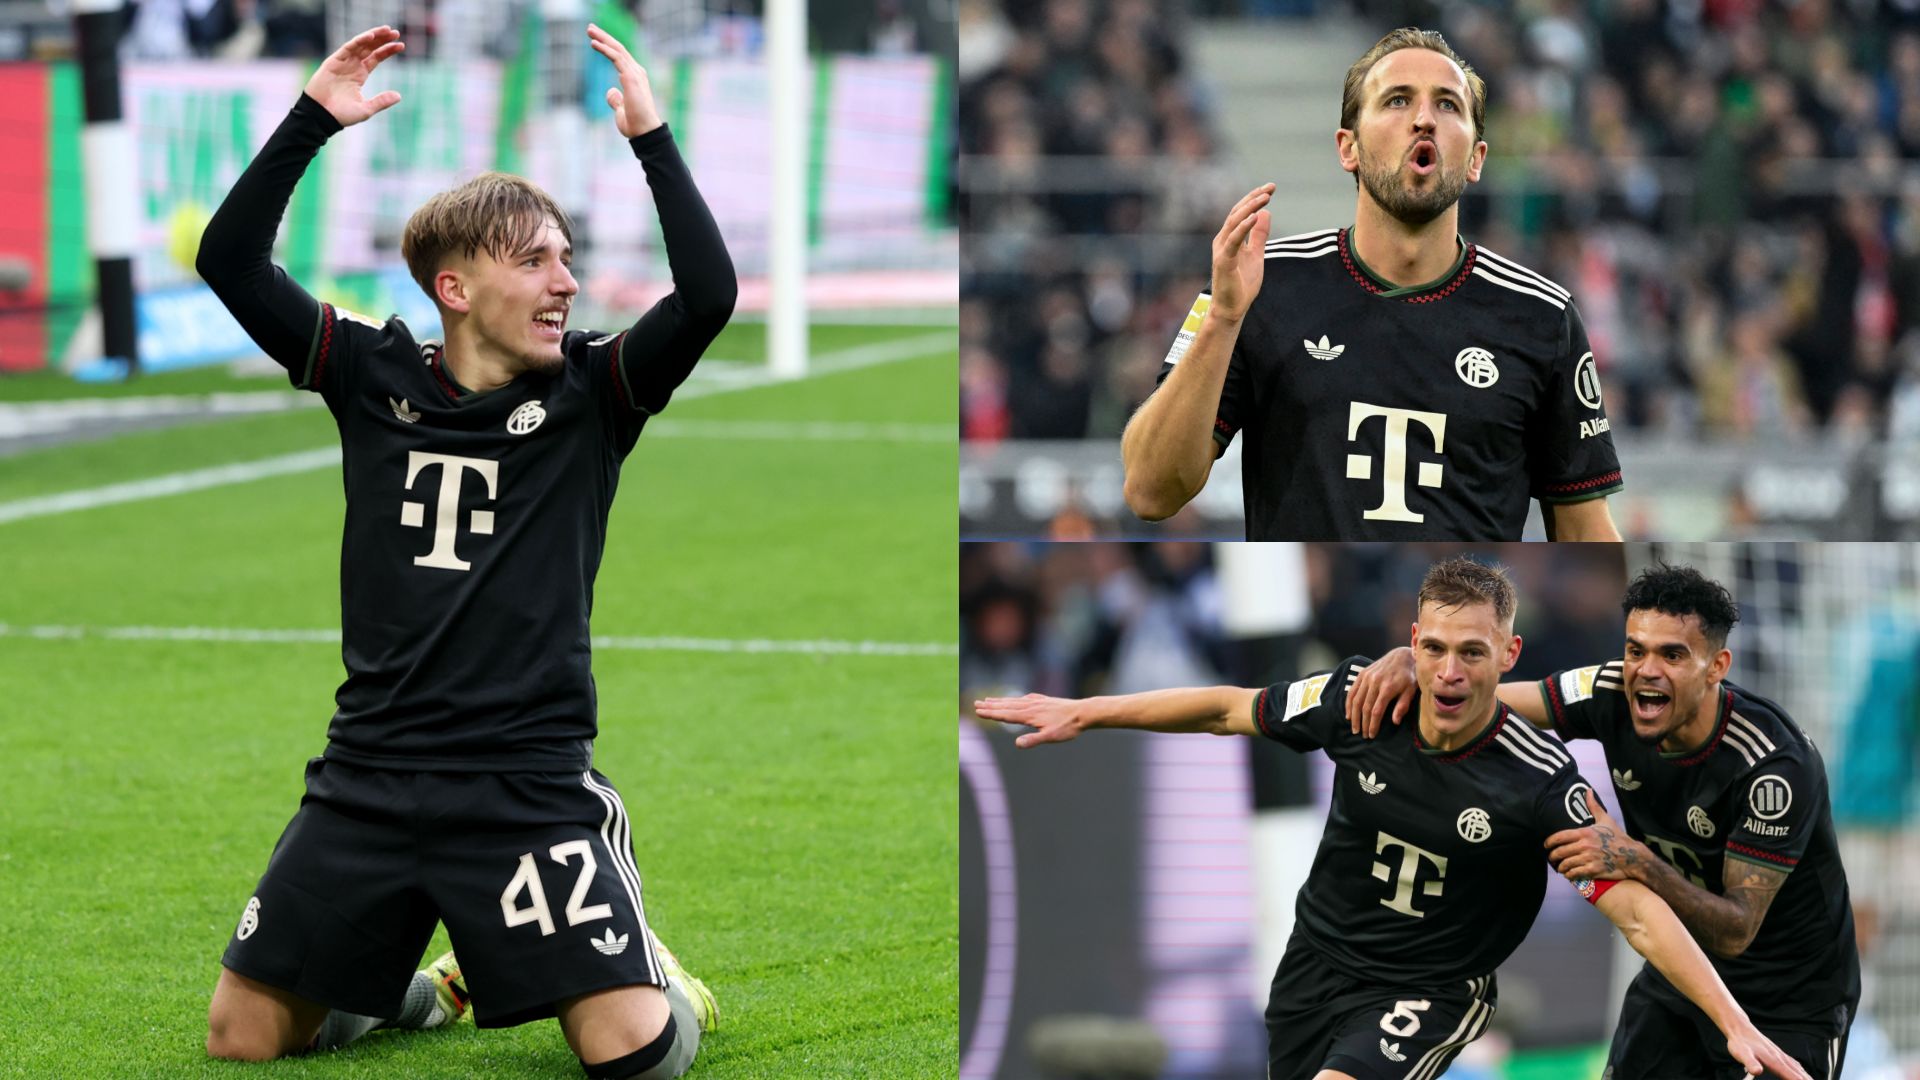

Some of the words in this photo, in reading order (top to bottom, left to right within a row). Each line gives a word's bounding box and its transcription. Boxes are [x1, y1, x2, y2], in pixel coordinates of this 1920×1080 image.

[1579, 417, 1610, 439] Allian
[1743, 816, 1790, 837] Allianz
[500, 839, 613, 936] 42
[1379, 999, 1431, 1037] 6
